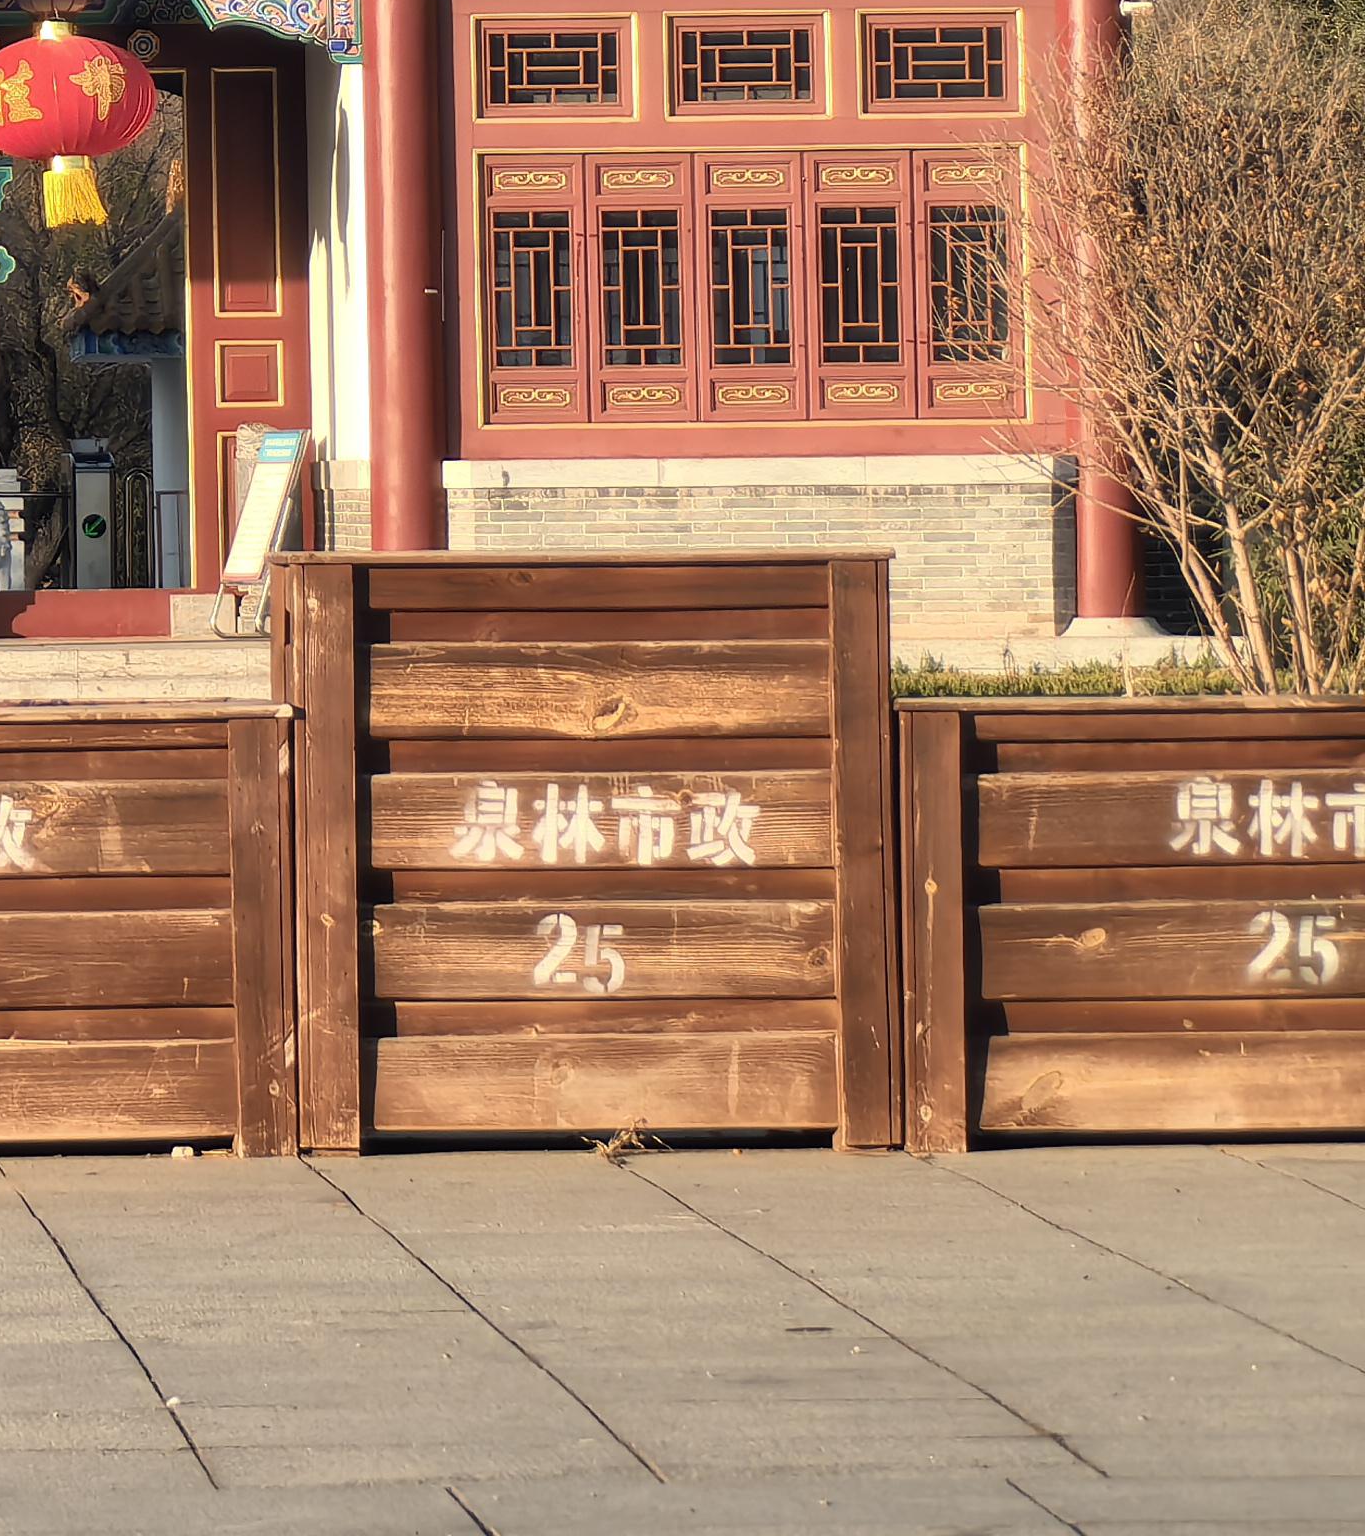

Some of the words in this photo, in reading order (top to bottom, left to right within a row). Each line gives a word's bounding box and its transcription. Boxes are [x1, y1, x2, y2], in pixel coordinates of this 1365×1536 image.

[449, 779, 761, 866] 泉林市政
[533, 913, 626, 994] 25
[1247, 910, 1340, 986] 25
